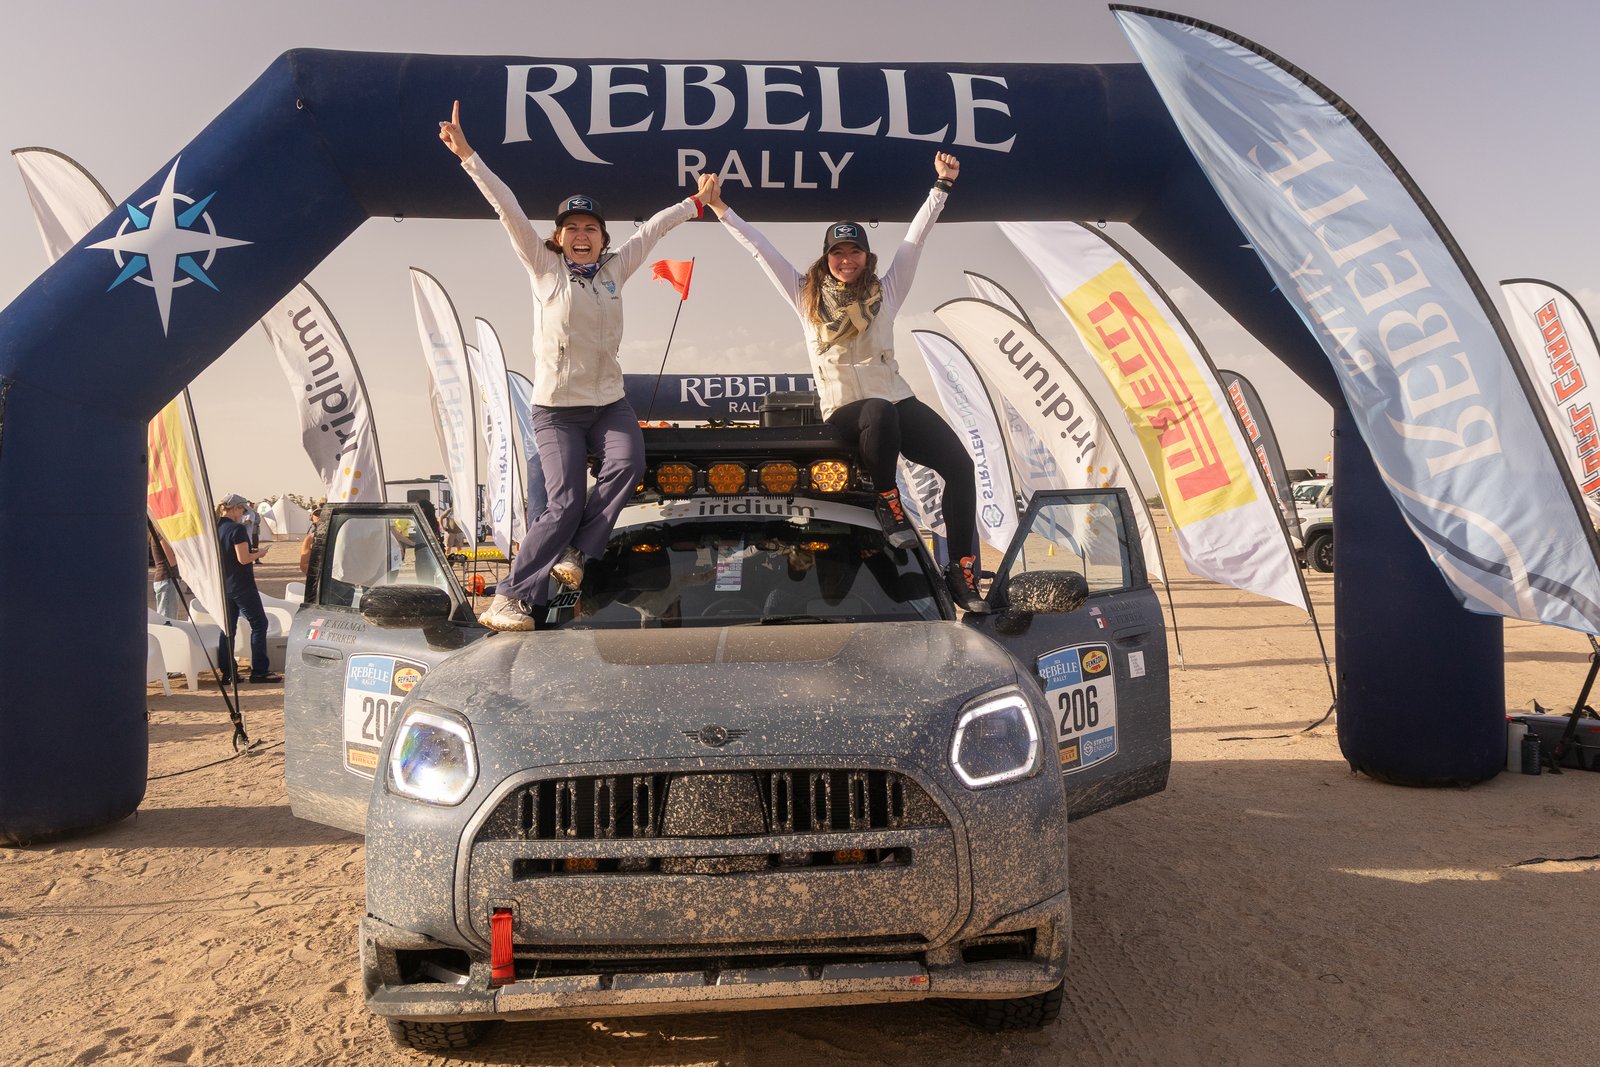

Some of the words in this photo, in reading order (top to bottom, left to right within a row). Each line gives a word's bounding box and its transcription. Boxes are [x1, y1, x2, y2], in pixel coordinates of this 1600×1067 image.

[502, 64, 1017, 165] REBELLE
[677, 148, 855, 190] RALLY
[679, 376, 817, 407] REBELL
[729, 401, 760, 413] RAL
[550, 591, 580, 608] 206
[351, 666, 389, 683] REBELLE
[1039, 661, 1079, 680] REBELLE
[1053, 675, 1067, 683] RALLY
[1058, 684, 1099, 736] 206
